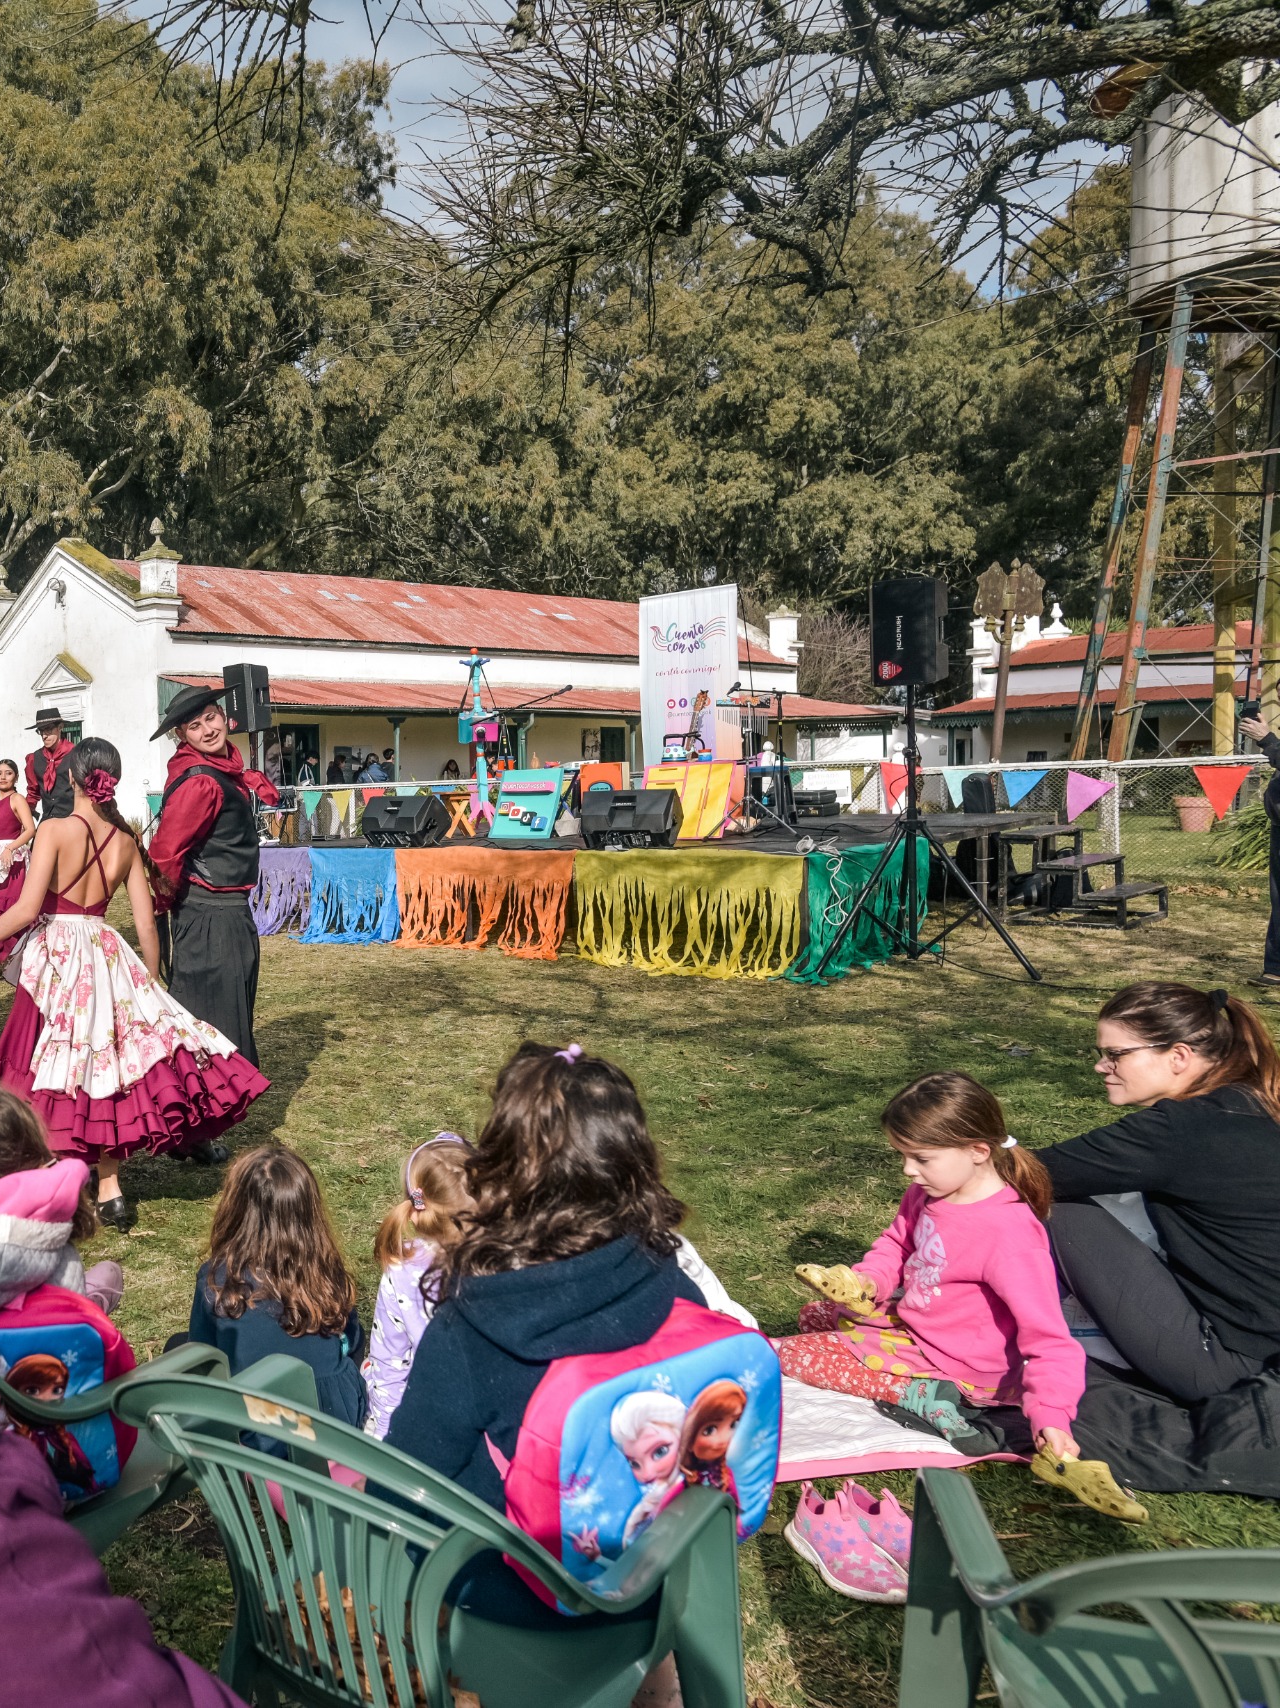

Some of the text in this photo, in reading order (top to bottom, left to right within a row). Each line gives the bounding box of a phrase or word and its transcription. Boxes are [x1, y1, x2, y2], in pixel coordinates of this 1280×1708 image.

[666, 622, 704, 642] Cuento
[667, 638, 706, 653] con vos
